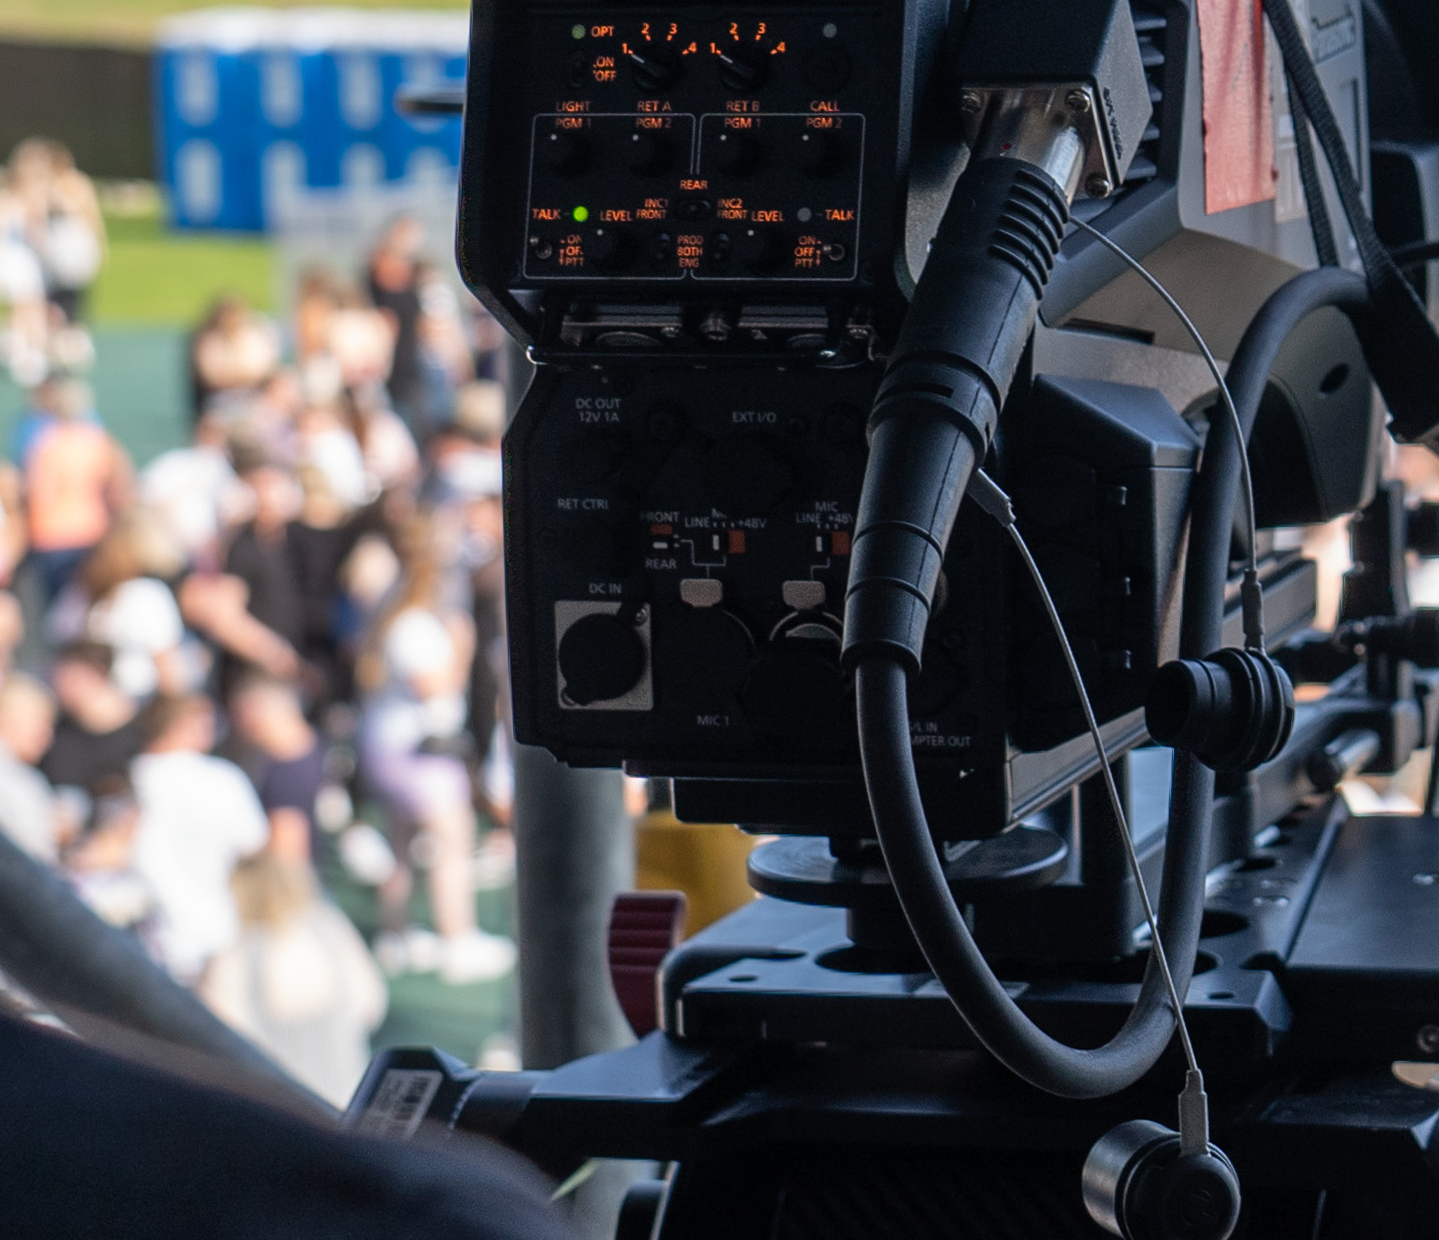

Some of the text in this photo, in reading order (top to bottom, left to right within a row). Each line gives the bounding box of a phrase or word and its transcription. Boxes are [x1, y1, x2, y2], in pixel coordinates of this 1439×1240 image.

[591, 25, 614, 38] OPT
[642, 23, 649, 34] 2
[670, 23, 678, 34] 3
[688, 42, 697, 53] 4
[730, 23, 738, 34] 2
[758, 23, 766, 34] 3
[776, 42, 786, 53] 4
[596, 56, 614, 68] ON
[595, 70, 617, 81] OFF
[556, 101, 590, 113] LIGHT
[637, 101, 672, 112] RET A
[726, 101, 760, 112] RET B
[810, 101, 840, 112] CALL
[556, 117, 583, 128] PGM
[636, 117, 672, 128] PGM 2
[724, 117, 752, 128] PGM
[806, 117, 843, 128] PGM 2
[680, 180, 708, 191] REAR
[717, 198, 743, 209] INC2
[532, 209, 561, 221] TALK
[600, 210, 632, 222] LEVEL
[636, 208, 666, 220] FRONT
[717, 209, 748, 220] FRONT
[751, 210, 784, 223] LEVEL
[825, 209, 854, 221] TALK
[798, 235, 815, 245] ON
[677, 246, 703, 257] BOTH
[794, 246, 815, 257] OFF
[565, 257, 585, 267] PTT
[678, 257, 700, 268] ENG
[794, 258, 813, 268] PTT
[575, 397, 622, 410] DC OUT
[578, 411, 620, 423] 12V 1A
[732, 411, 777, 424] EXT I/O
[557, 498, 578, 510] RET
[814, 500, 839, 513] MIC
[684, 516, 767, 529] LINE +48V
[795, 512, 822, 524] LINE
[645, 558, 677, 570] REAR
[589, 582, 622, 594] DC IN
[696, 714, 720, 727] MIC
[926, 721, 938, 733] IN
[911, 735, 972, 748] MPTER OUT
